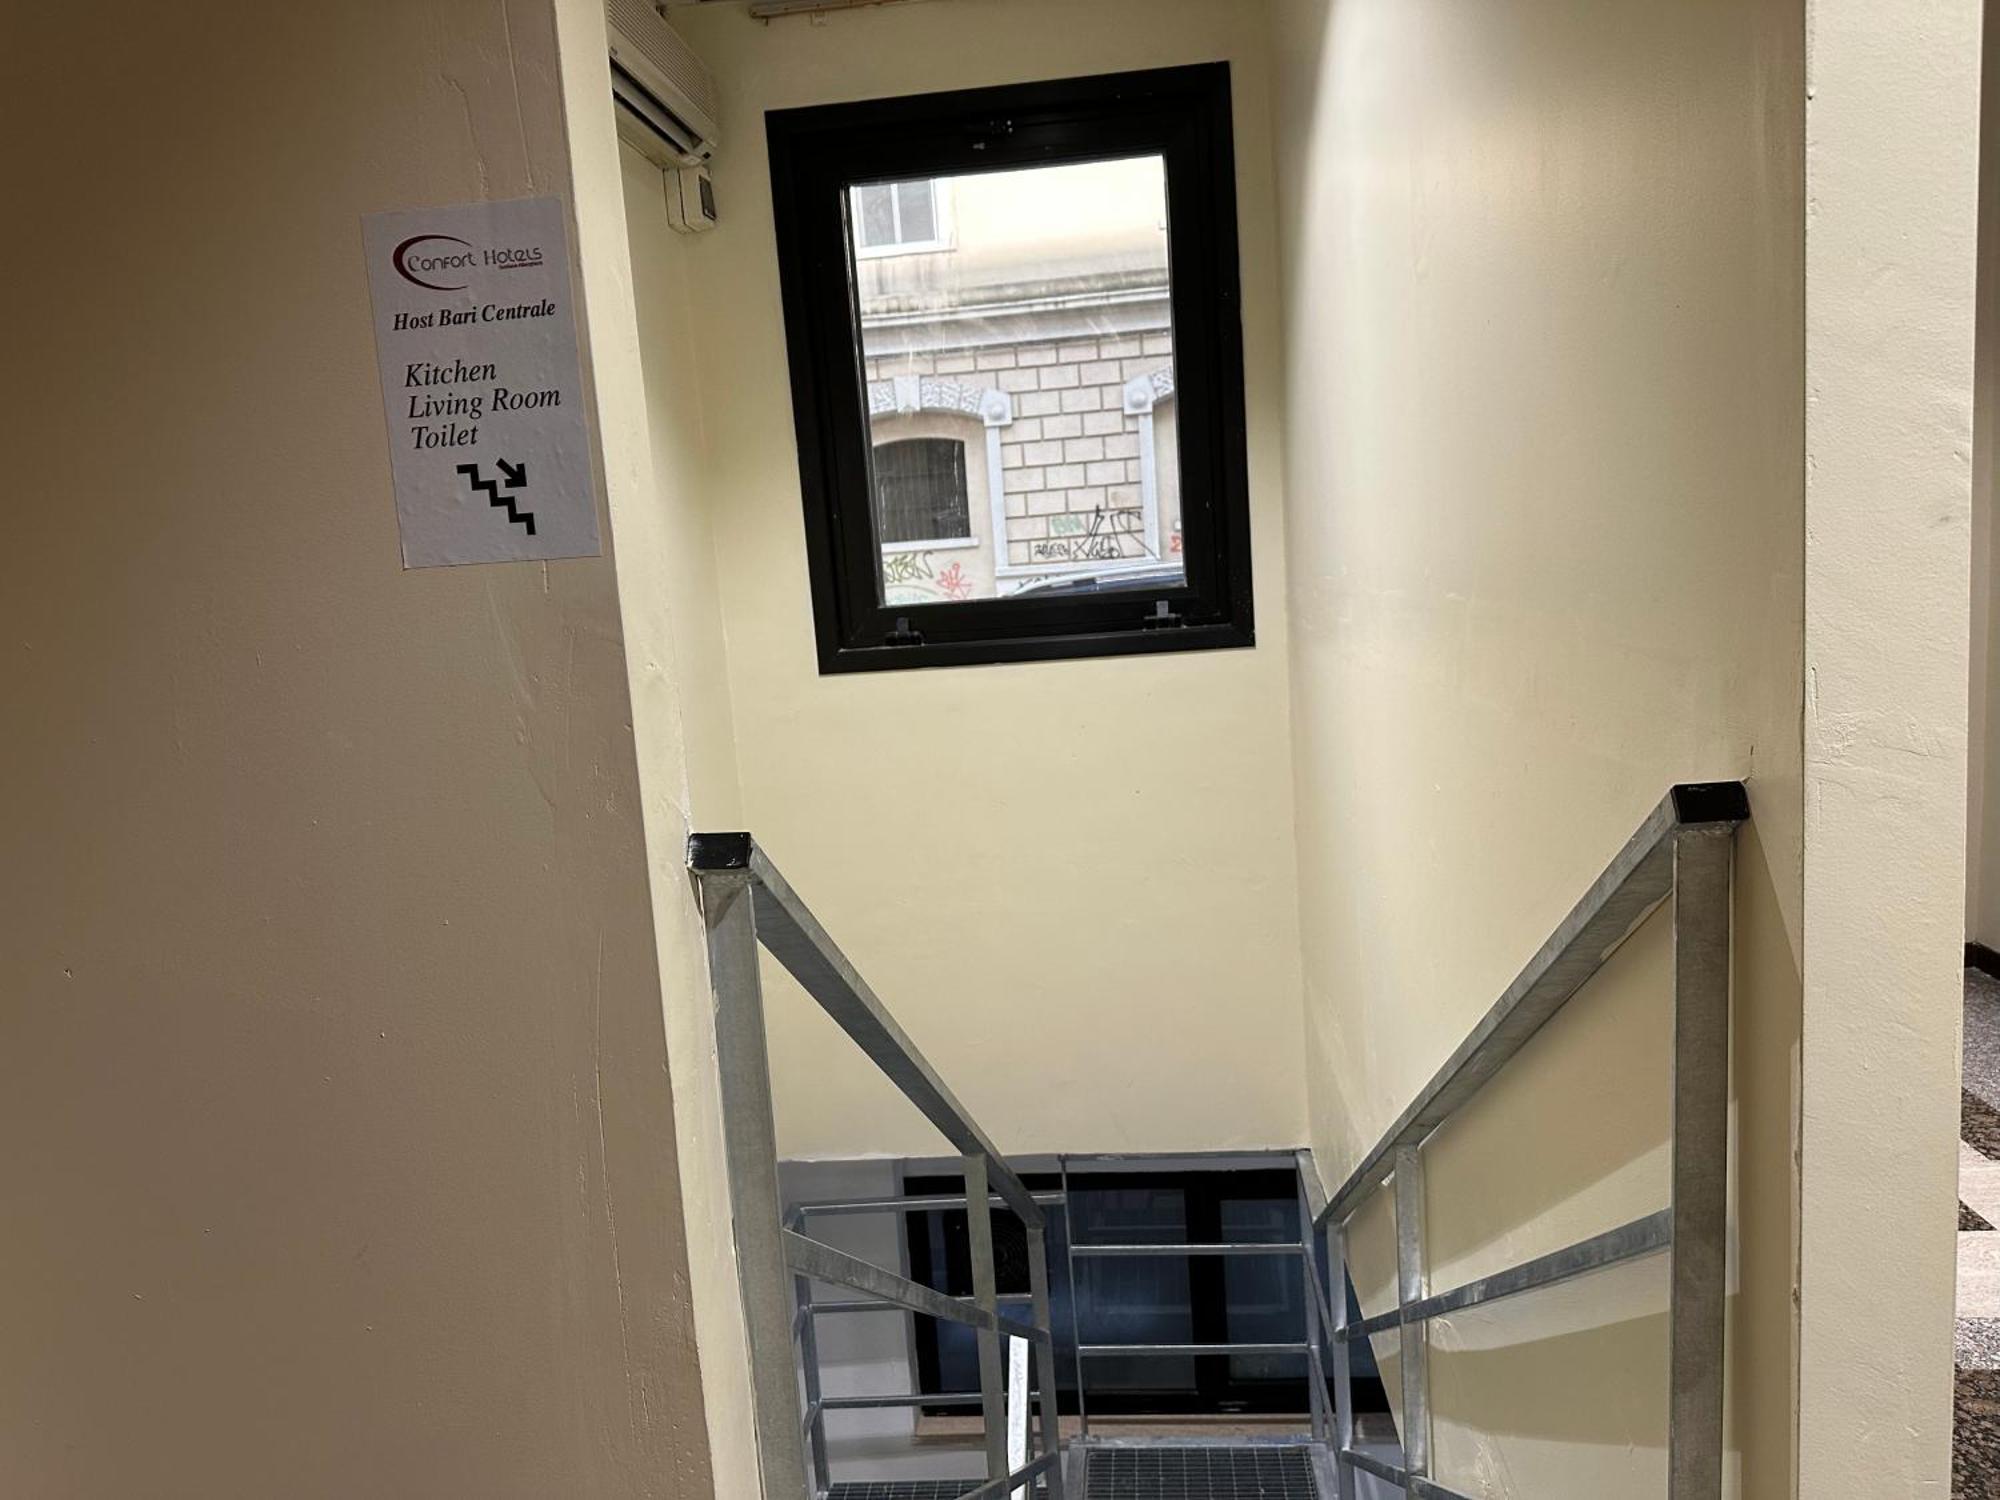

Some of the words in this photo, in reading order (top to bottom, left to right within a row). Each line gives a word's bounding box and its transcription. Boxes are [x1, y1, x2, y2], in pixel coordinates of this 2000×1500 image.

[407, 251, 477, 272] Confort
[483, 247, 543, 265] Hotels
[392, 312, 434, 331] Host
[439, 306, 477, 326] Bari
[482, 299, 556, 322] Centrale
[405, 359, 497, 388] Kitchen
[408, 393, 482, 420] Living
[491, 387, 561, 412] Room
[411, 423, 479, 449] Toilet
